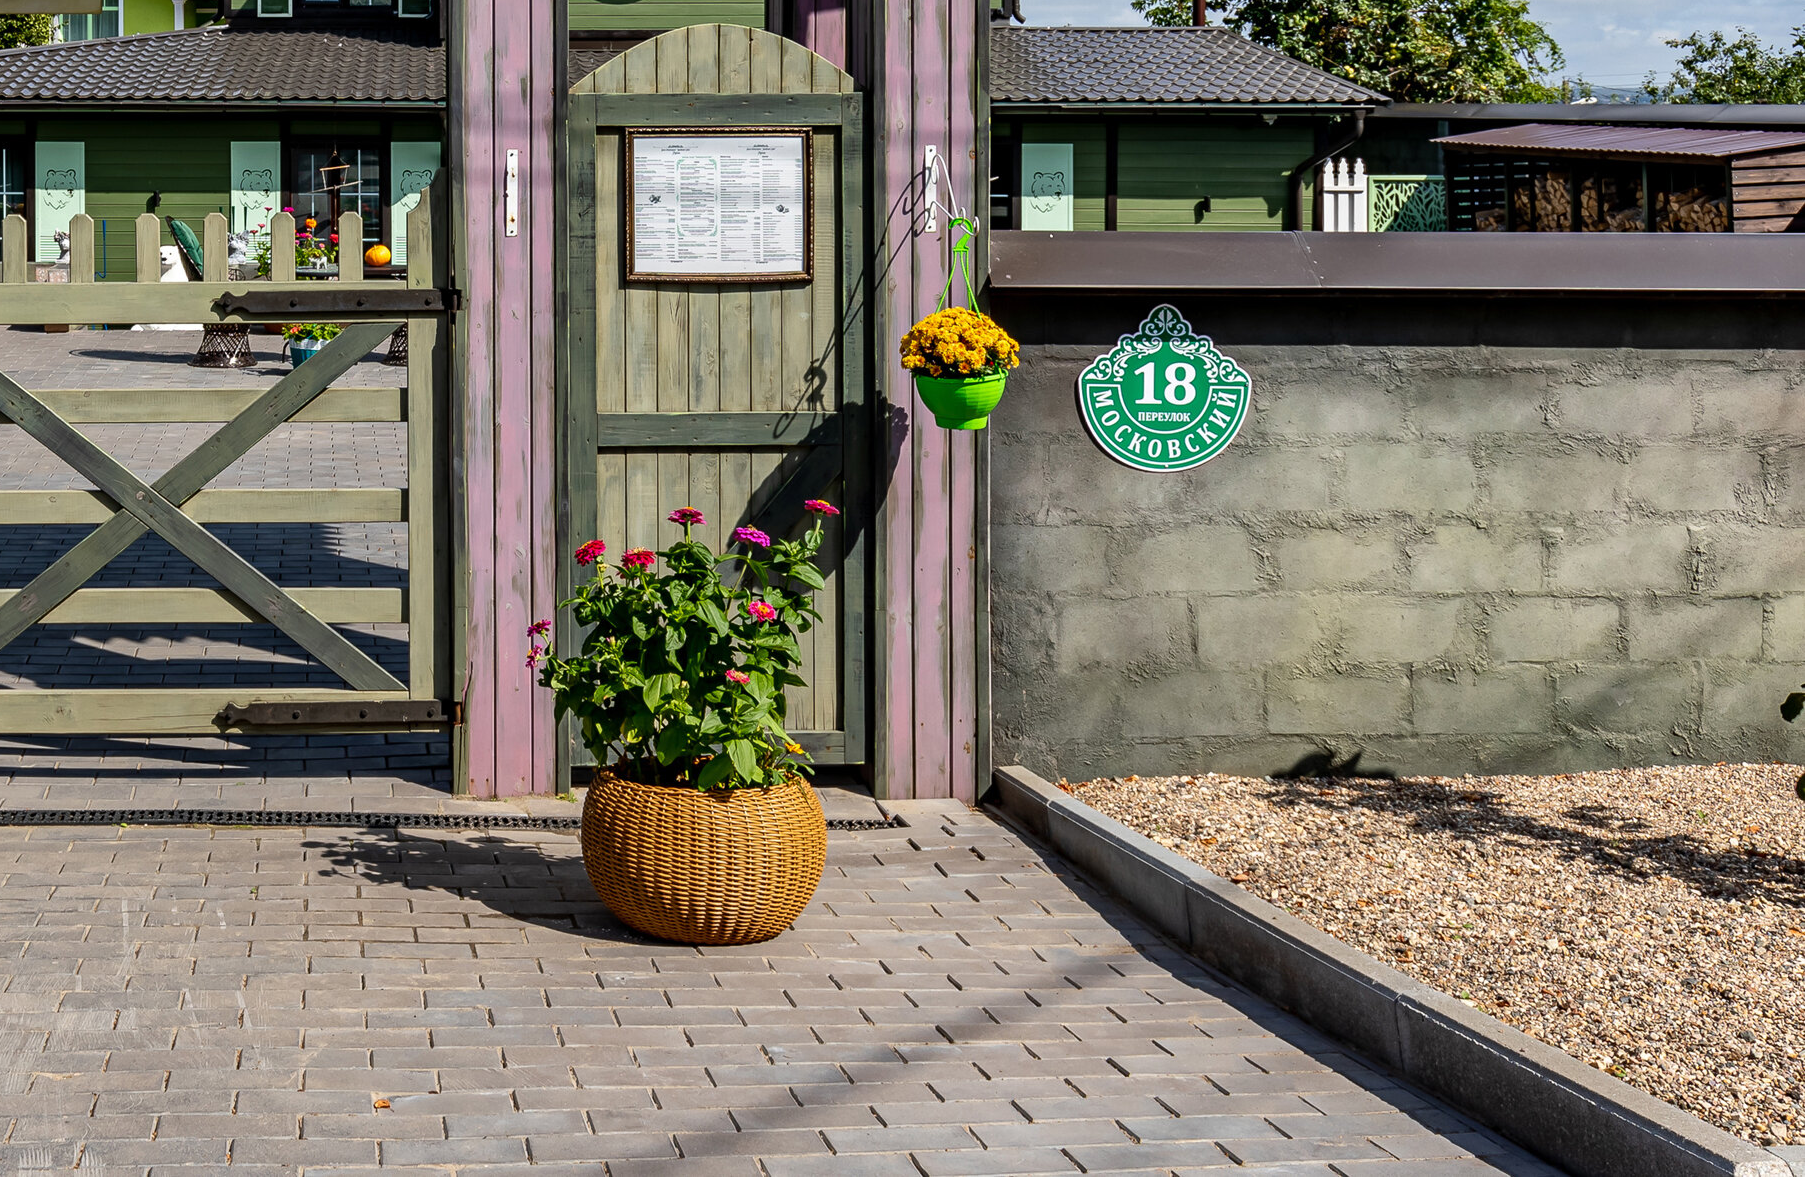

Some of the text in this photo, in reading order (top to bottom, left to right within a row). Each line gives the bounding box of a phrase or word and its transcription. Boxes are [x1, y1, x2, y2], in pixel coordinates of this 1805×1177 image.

[1134, 362, 1197, 405] 18
[1093, 389, 1238, 459] МОСКОВСКИЙ
[1137, 411, 1191, 422] ПЕРЕУЛОК
